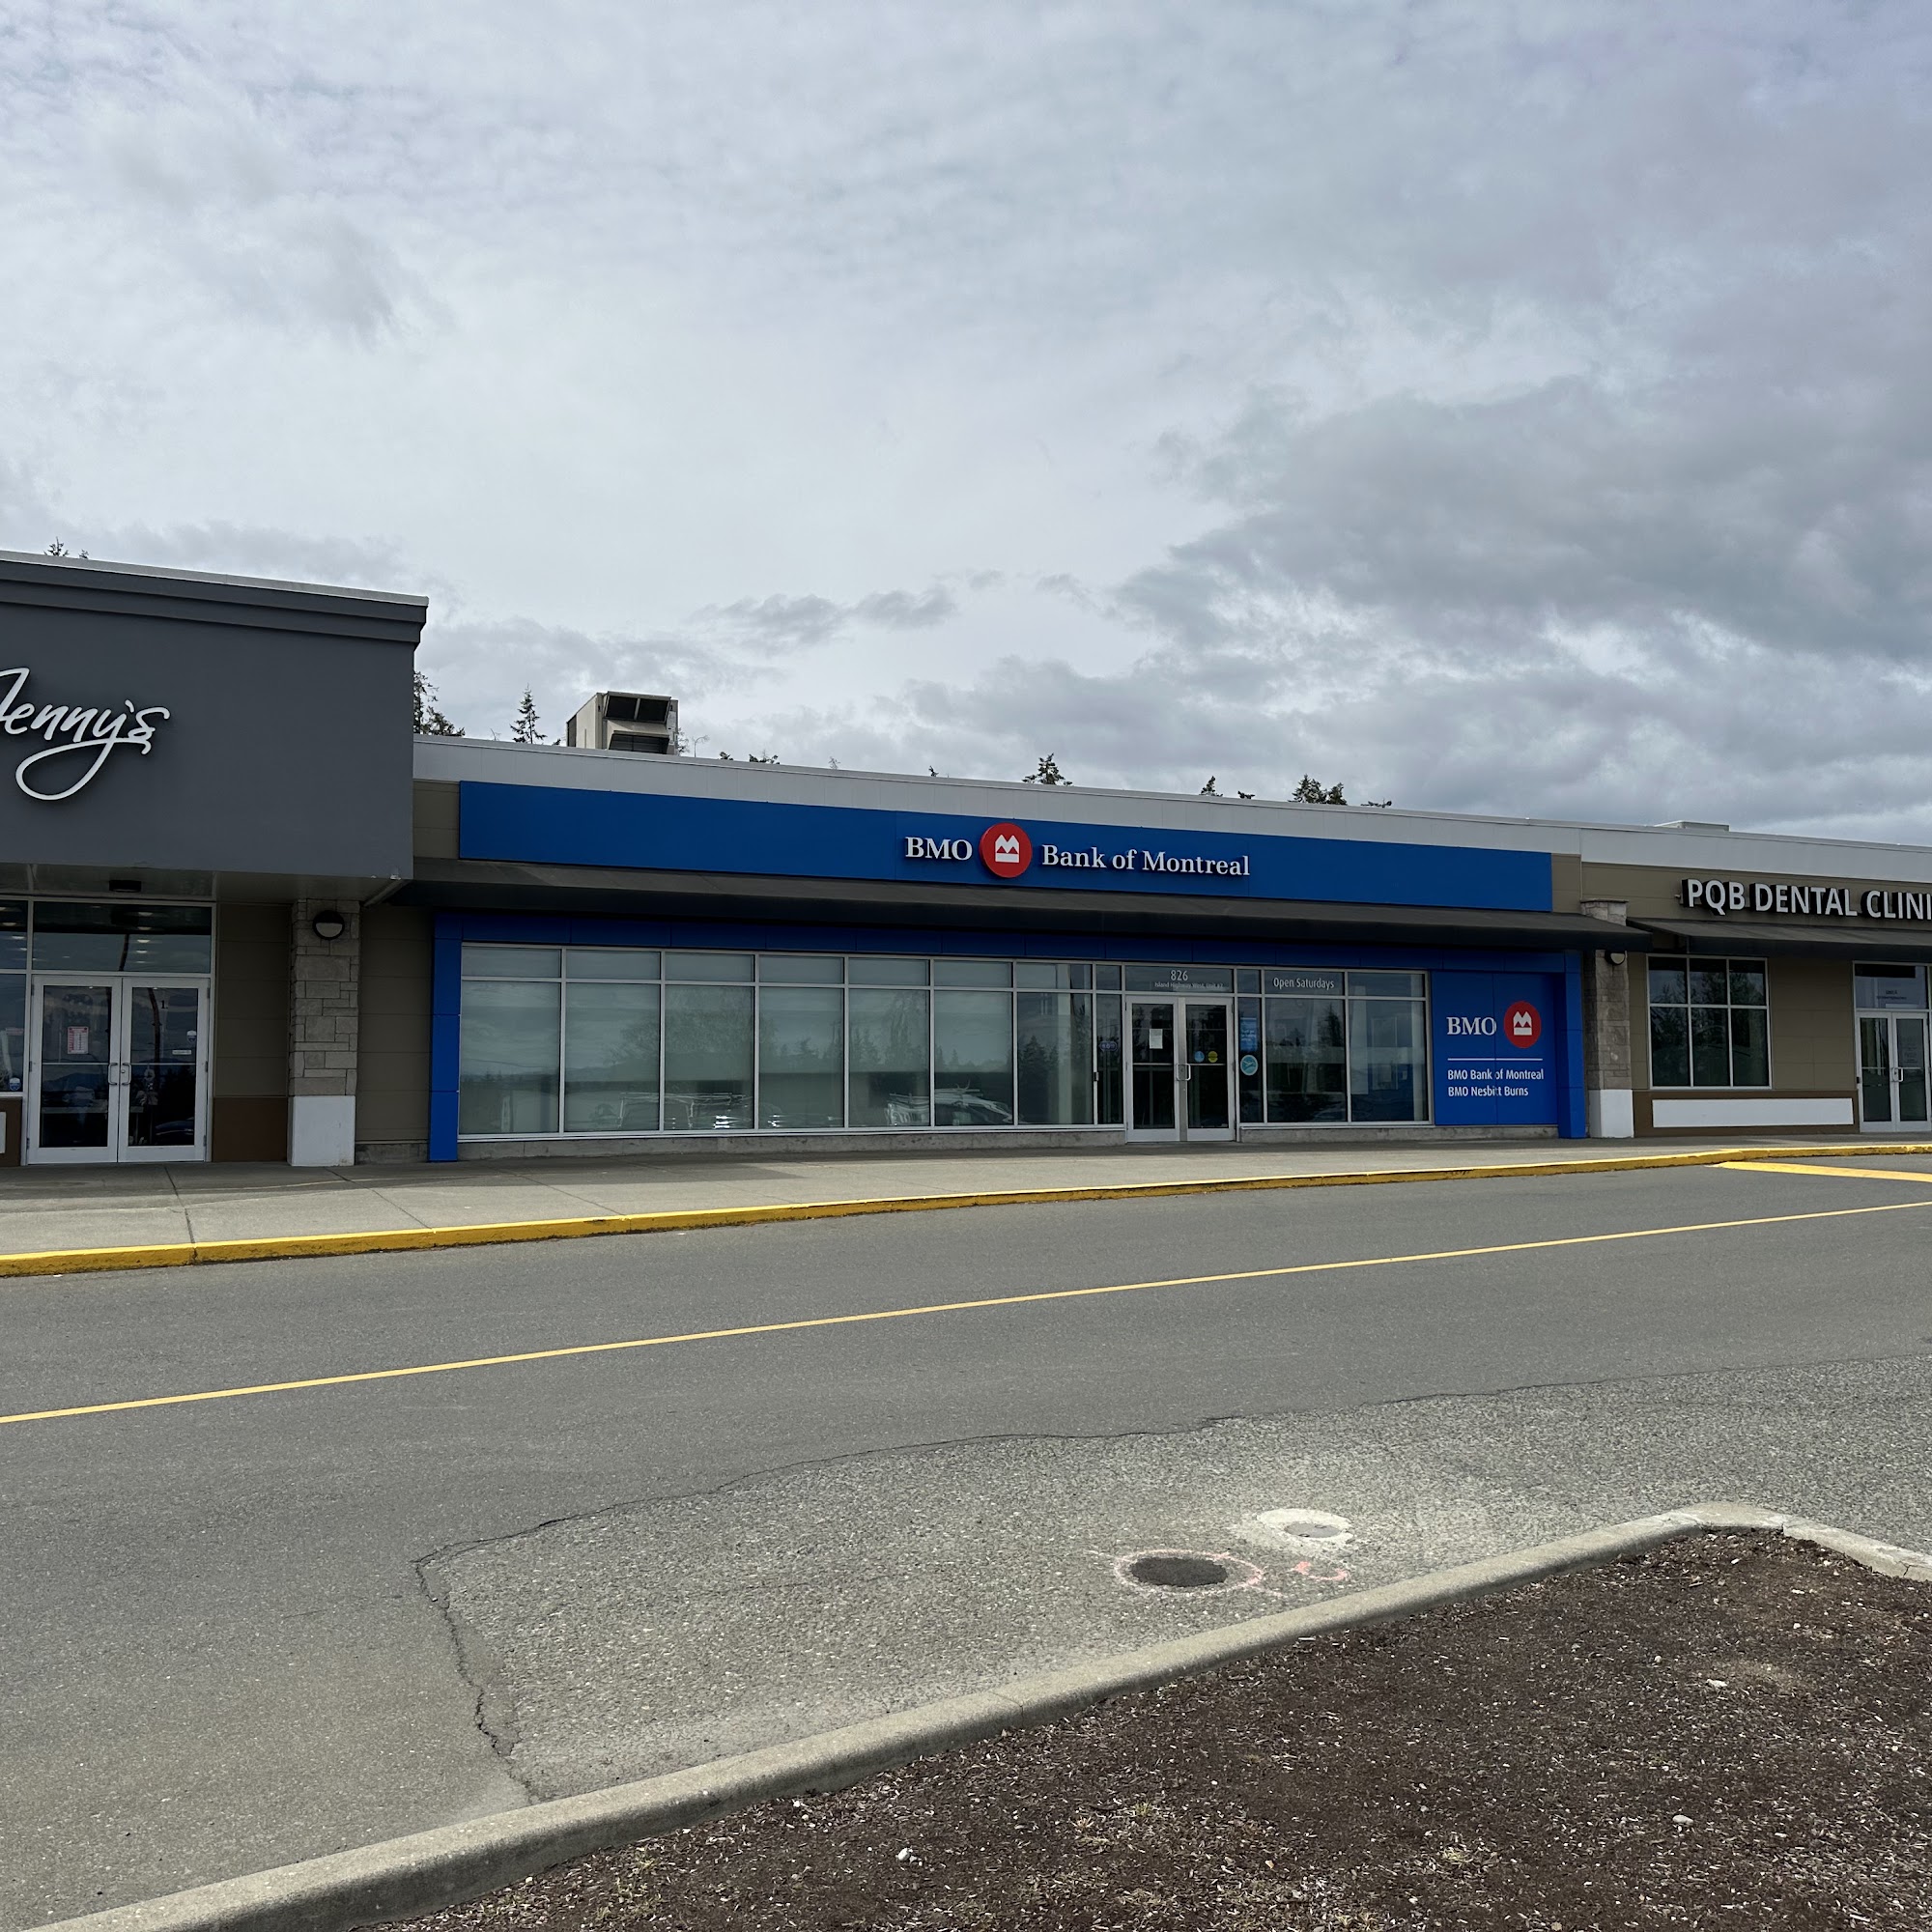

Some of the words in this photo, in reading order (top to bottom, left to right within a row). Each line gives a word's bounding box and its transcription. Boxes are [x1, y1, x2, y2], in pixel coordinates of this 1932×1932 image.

[905, 837, 973, 861] BMO
[1042, 844, 1107, 869] Bank
[1113, 849, 1138, 870] of
[1142, 850, 1250, 876] Montreal
[1688, 879, 1747, 916] PQB
[1754, 883, 1859, 917] DENTAL
[1170, 969, 1189, 981] 826
[1273, 977, 1294, 990] Open
[1295, 978, 1335, 991] Saturdays
[1446, 1016, 1497, 1037] BMO
[1447, 1069, 1468, 1080] BMO
[1470, 1068, 1492, 1080] Bank
[1494, 1068, 1503, 1080] of
[1505, 1068, 1544, 1080] Montreal
[1448, 1086, 1468, 1097] BMO
[1470, 1085, 1502, 1096] Nesbitt
[1504, 1086, 1529, 1096] Burns
